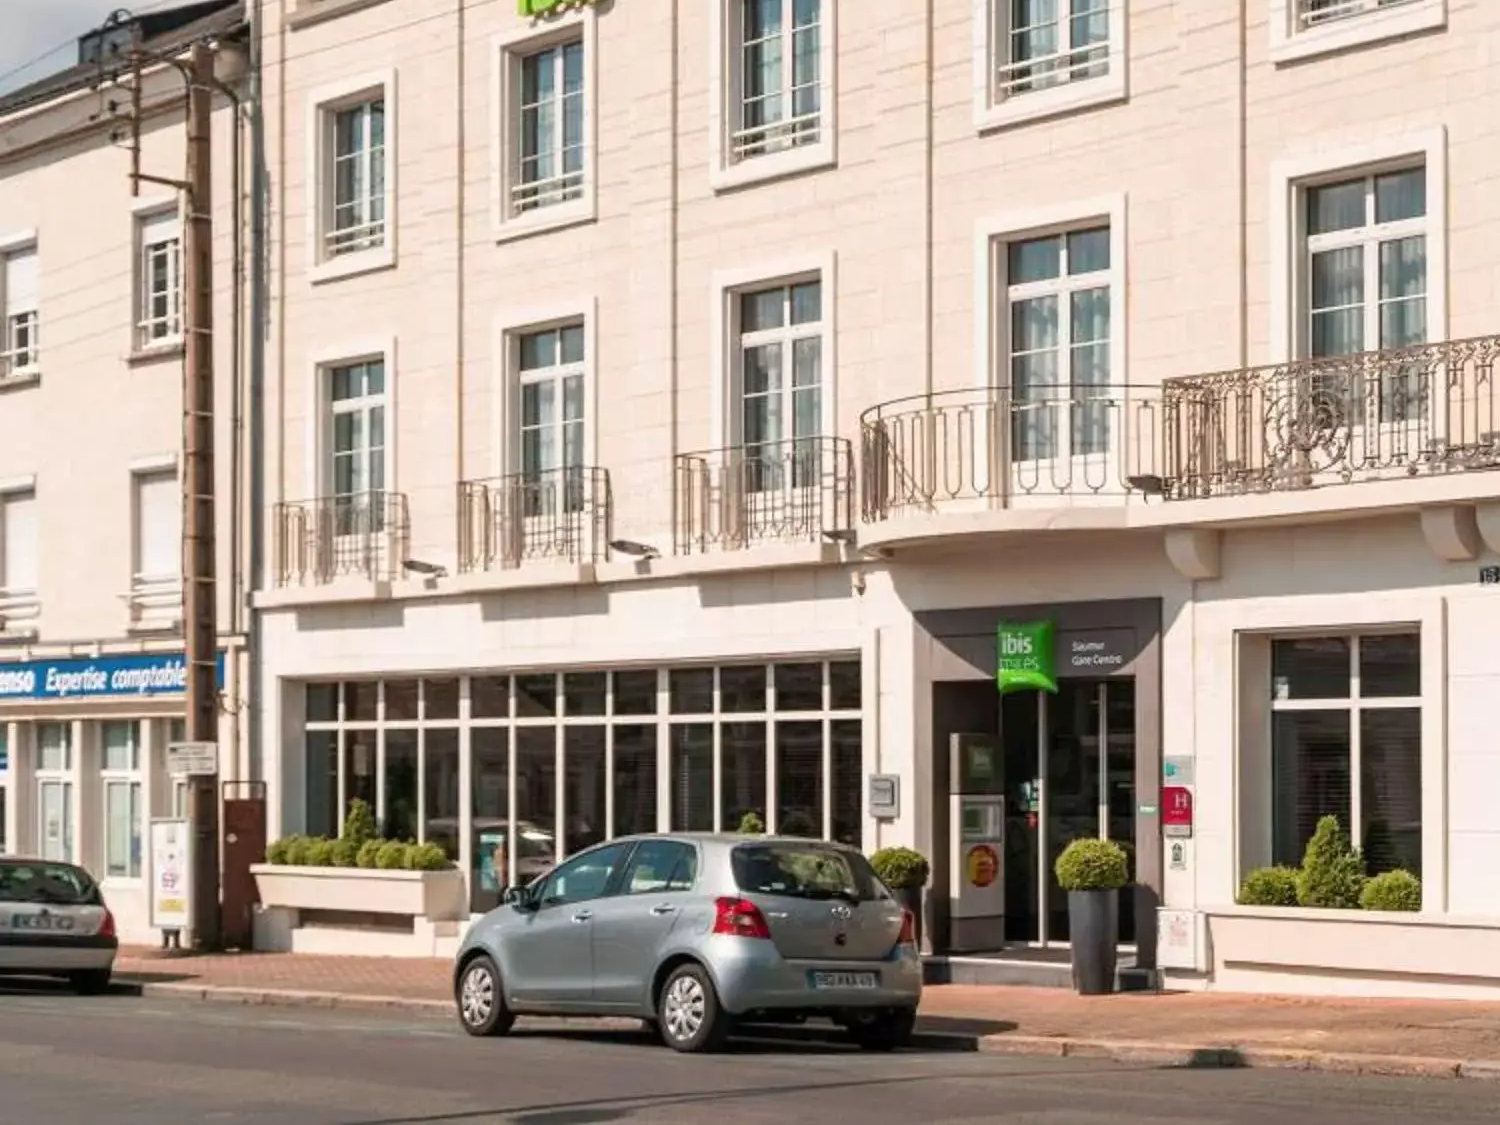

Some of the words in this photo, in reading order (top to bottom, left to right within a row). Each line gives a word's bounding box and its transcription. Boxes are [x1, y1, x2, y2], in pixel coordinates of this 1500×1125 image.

[1001, 631, 1033, 655] ibis
[45, 664, 109, 696] Expertise
[111, 659, 188, 695] comptable
[1174, 793, 1188, 808] H
